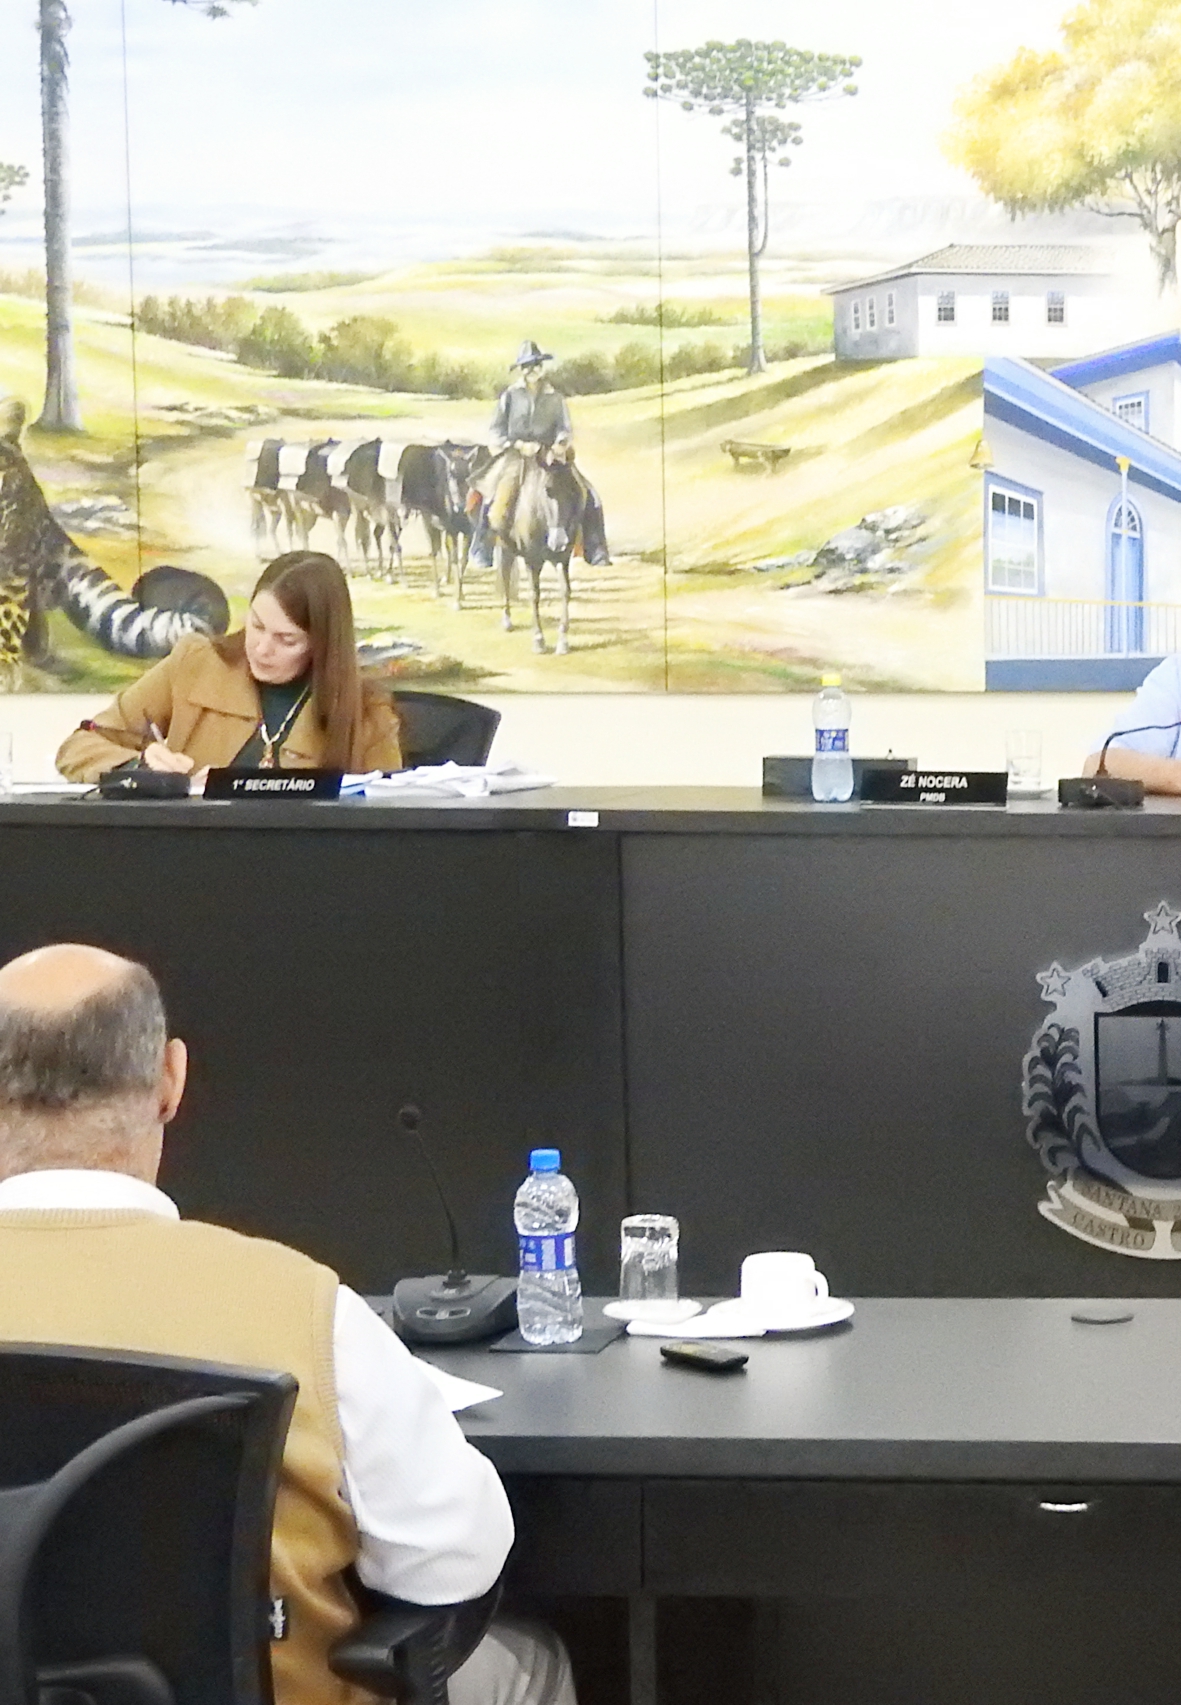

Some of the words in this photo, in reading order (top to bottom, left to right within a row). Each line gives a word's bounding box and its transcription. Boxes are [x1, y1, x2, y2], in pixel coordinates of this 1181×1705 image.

[244, 777, 316, 792] SECRETÁRIO
[899, 773, 915, 789] ZÉ
[917, 775, 969, 789] NOCERA
[919, 792, 946, 803] PMDB
[1072, 1211, 1146, 1247] CASTRO
